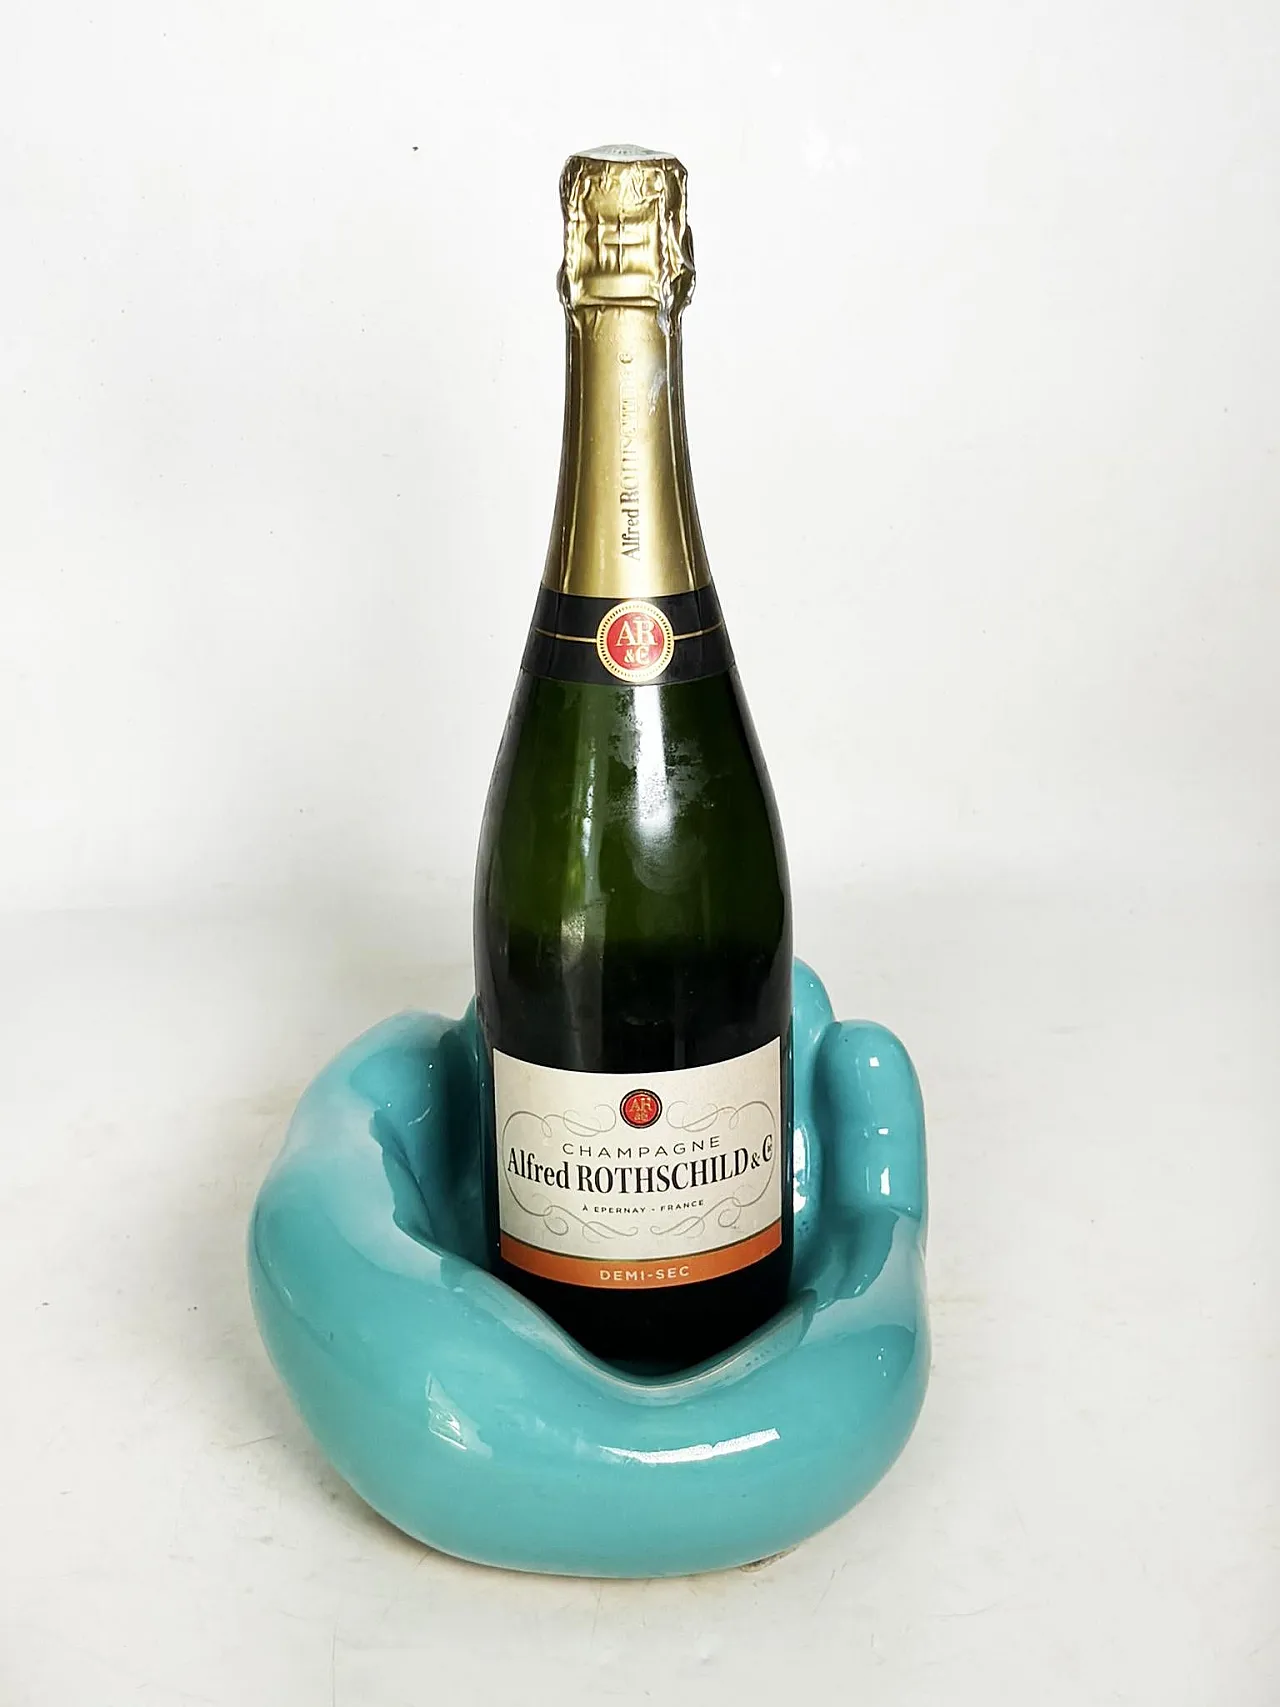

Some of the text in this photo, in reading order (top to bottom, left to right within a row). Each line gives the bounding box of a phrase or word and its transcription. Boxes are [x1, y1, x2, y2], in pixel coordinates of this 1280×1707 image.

[621, 507, 640, 560] Alfred
[615, 619, 658, 647] AR
[562, 1135, 721, 1158] CHAMPAGNE
[507, 1147, 570, 1190] Alfred
[576, 1147, 749, 1194] ROTHSCHILD
[594, 1206, 646, 1214] EPERNAY
[660, 1199, 704, 1212] FRANCE
[599, 1265, 690, 1281] DEMI-SEC
